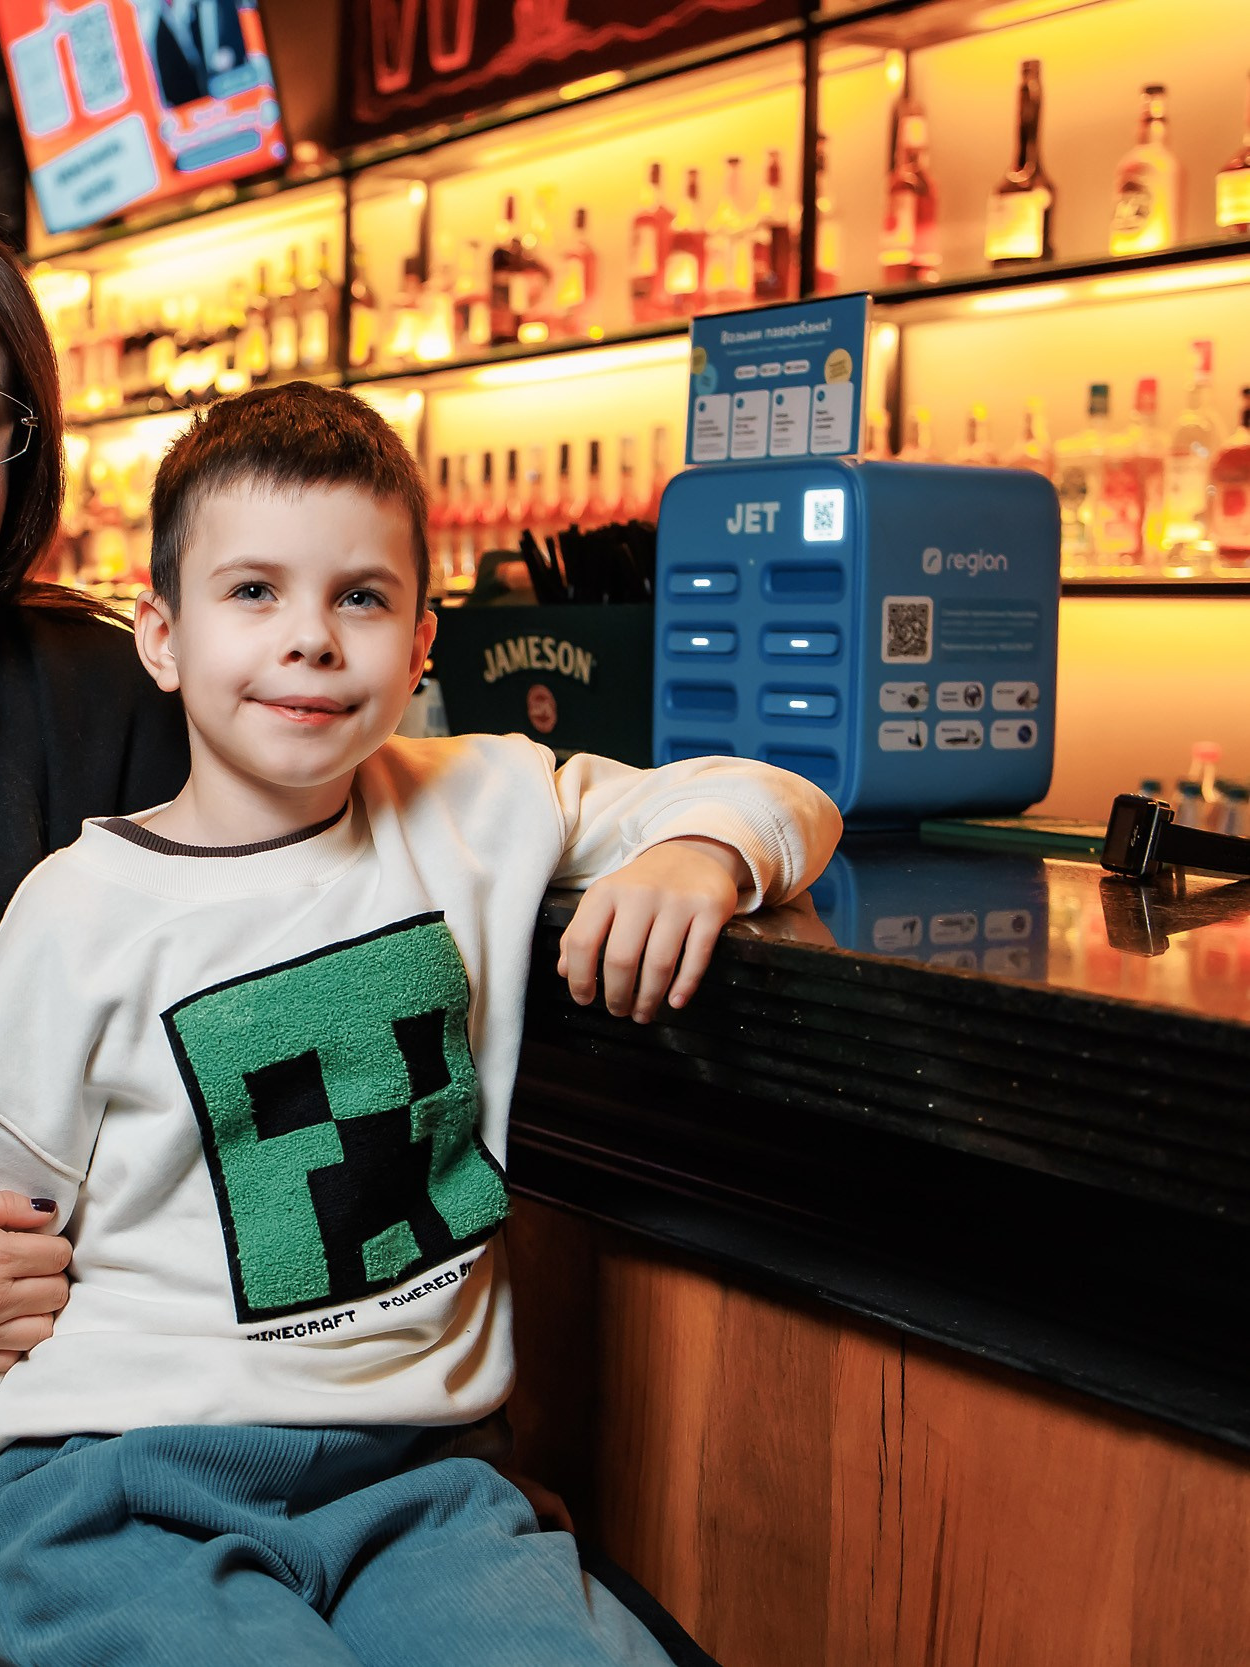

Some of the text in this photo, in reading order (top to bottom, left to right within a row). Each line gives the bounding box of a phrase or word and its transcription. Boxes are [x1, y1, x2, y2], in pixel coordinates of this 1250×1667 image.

[726, 501, 781, 534] JET
[946, 549, 1008, 577] region
[483, 636, 593, 685] JAMESON
[246, 1309, 356, 1342] MINECRAFT
[378, 1270, 459, 1312] POWERED
